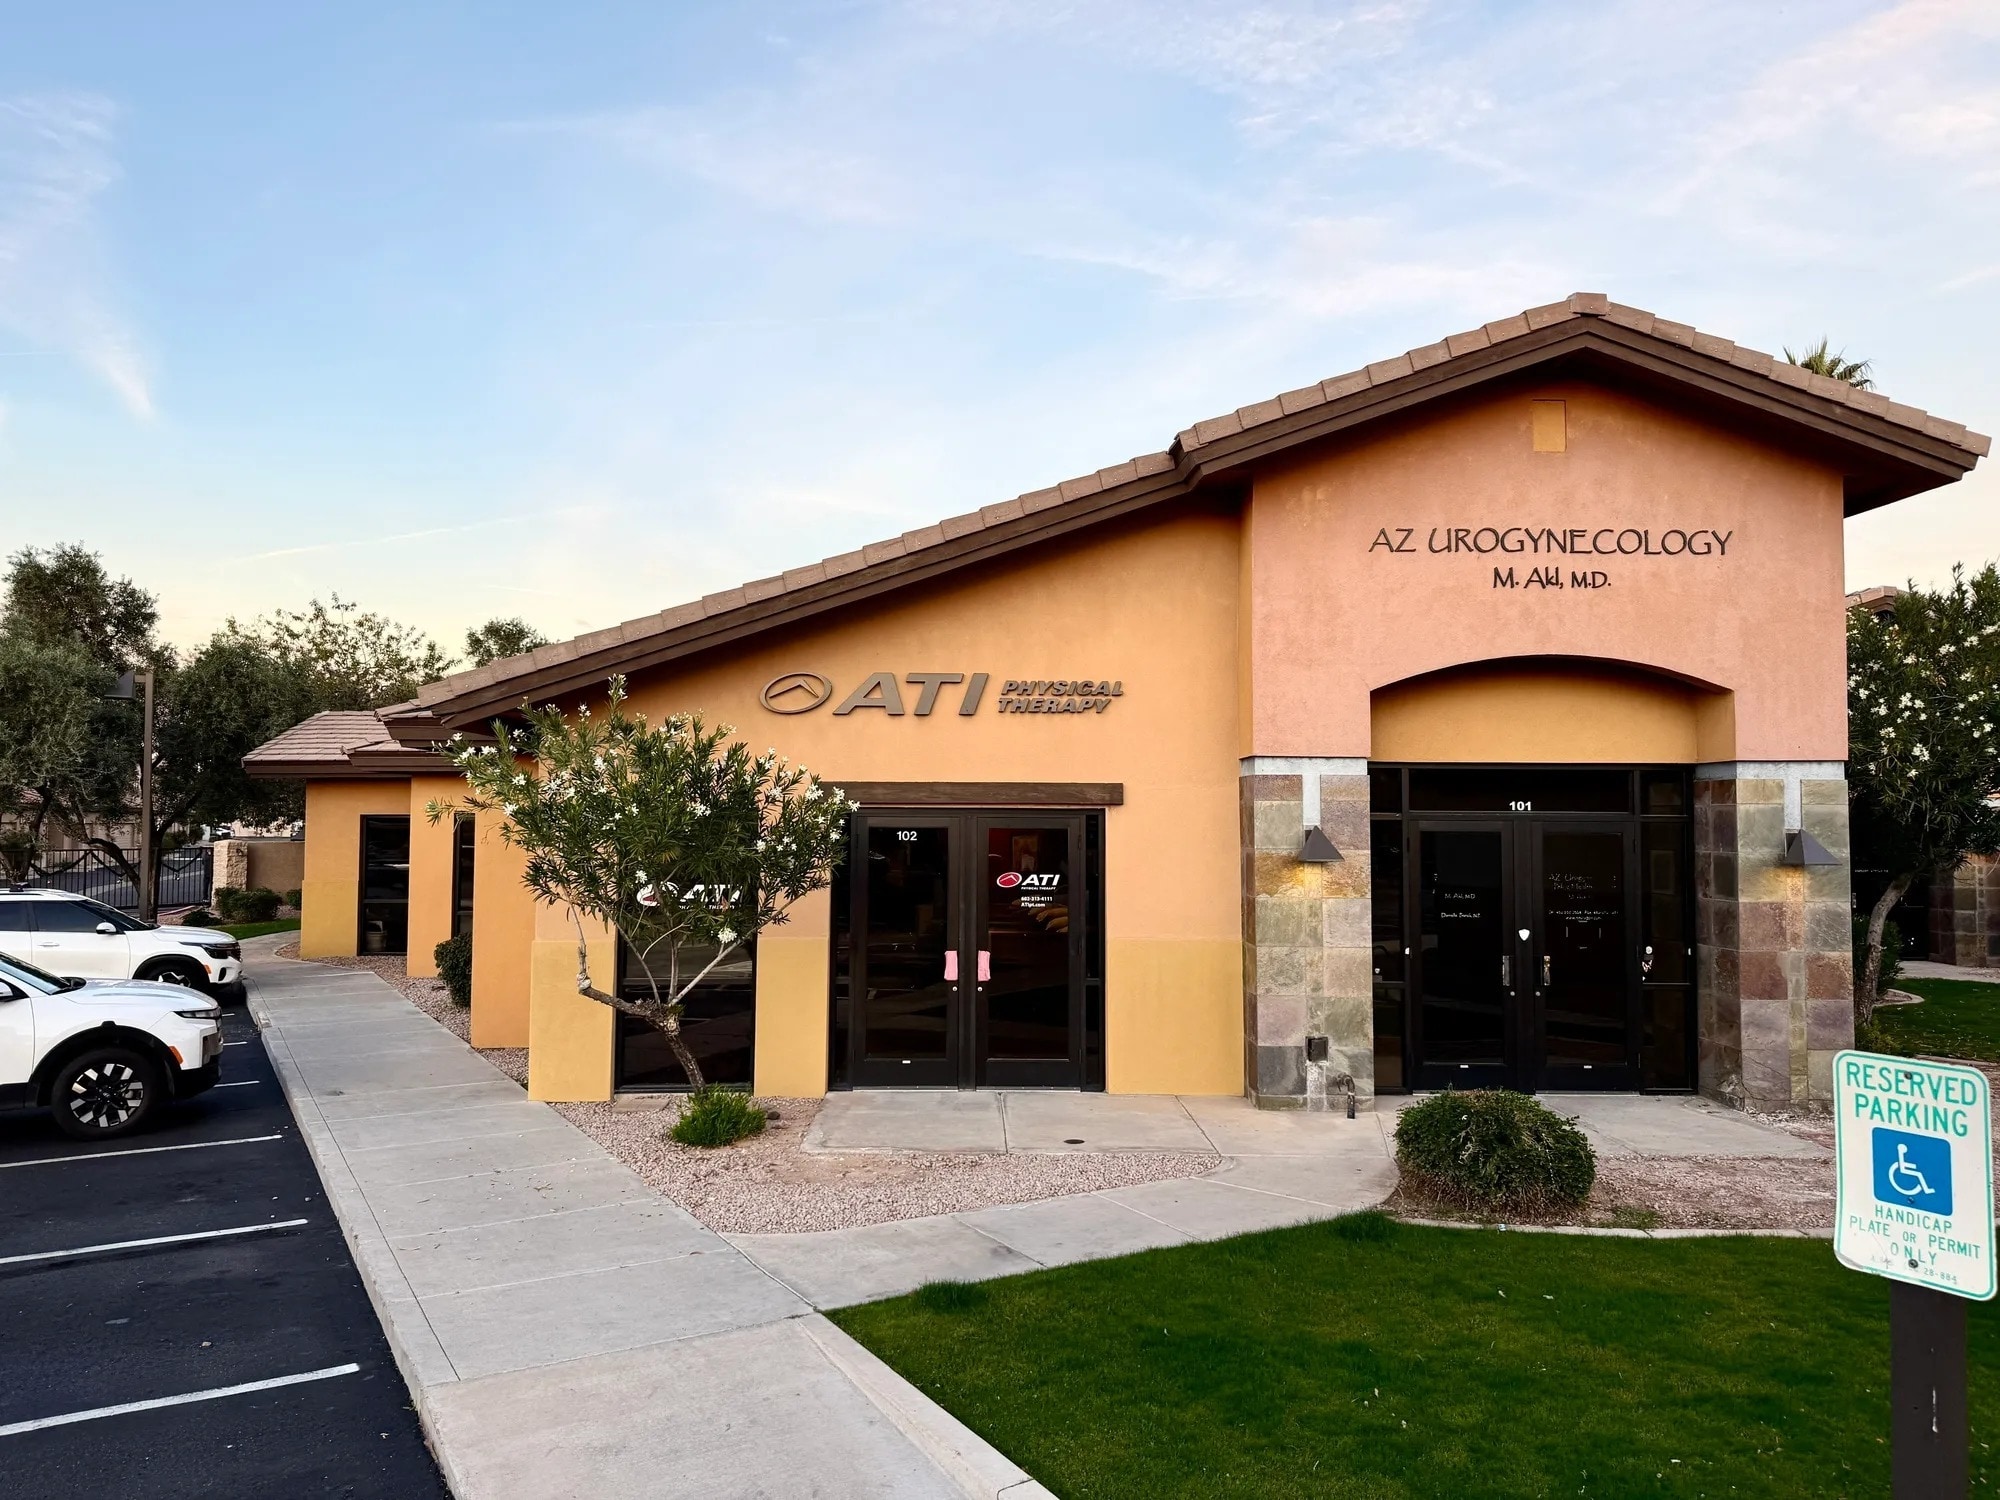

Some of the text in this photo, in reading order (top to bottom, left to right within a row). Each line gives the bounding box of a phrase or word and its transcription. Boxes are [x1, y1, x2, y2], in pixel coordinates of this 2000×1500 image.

[1368, 527, 1733, 556] AZ UROGYNECOLOGY
[1493, 566, 1519, 589] M.
[1571, 571, 1612, 589] M.D.
[832, 671, 990, 716] ATI
[1000, 679, 1124, 697] PHYSICAL
[997, 697, 1112, 715] THERAPY
[1509, 800, 1531, 811] 101
[896, 830, 918, 842] 102
[1021, 873, 1060, 886] ATI
[1845, 1060, 1977, 1107] RESERVED
[1855, 1092, 1968, 1138] PARKING
[1874, 1204, 1953, 1234] HANDICAP
[1850, 1215, 1981, 1260] PLATE OR PERMIT
[1890, 1242, 1937, 1266] ONLY
